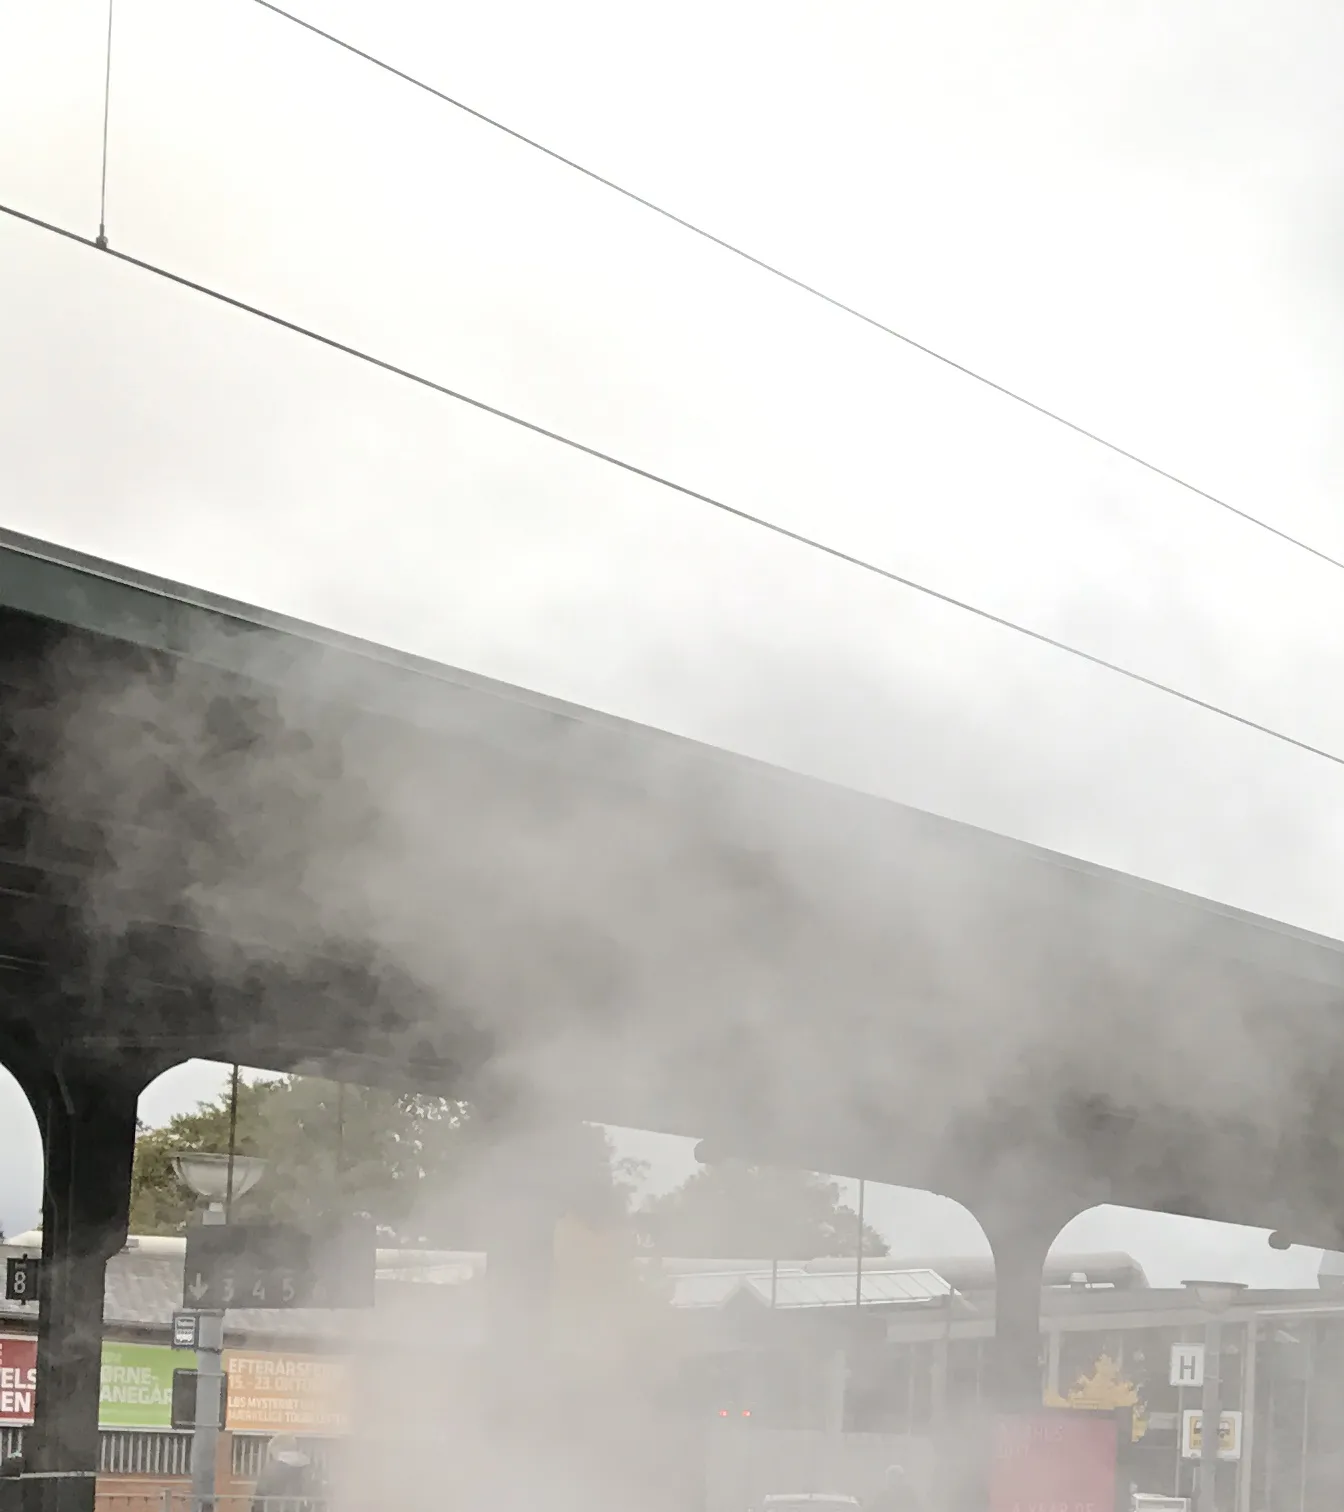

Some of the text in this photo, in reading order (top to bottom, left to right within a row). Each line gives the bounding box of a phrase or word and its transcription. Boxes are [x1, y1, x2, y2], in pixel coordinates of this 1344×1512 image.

[14, 1271, 26, 1294] 8
[223, 1278, 235, 1301] 3
[252, 1278, 266, 1300] 4
[282, 1278, 296, 1301] 5
[1180, 1355, 1195, 1380] H
